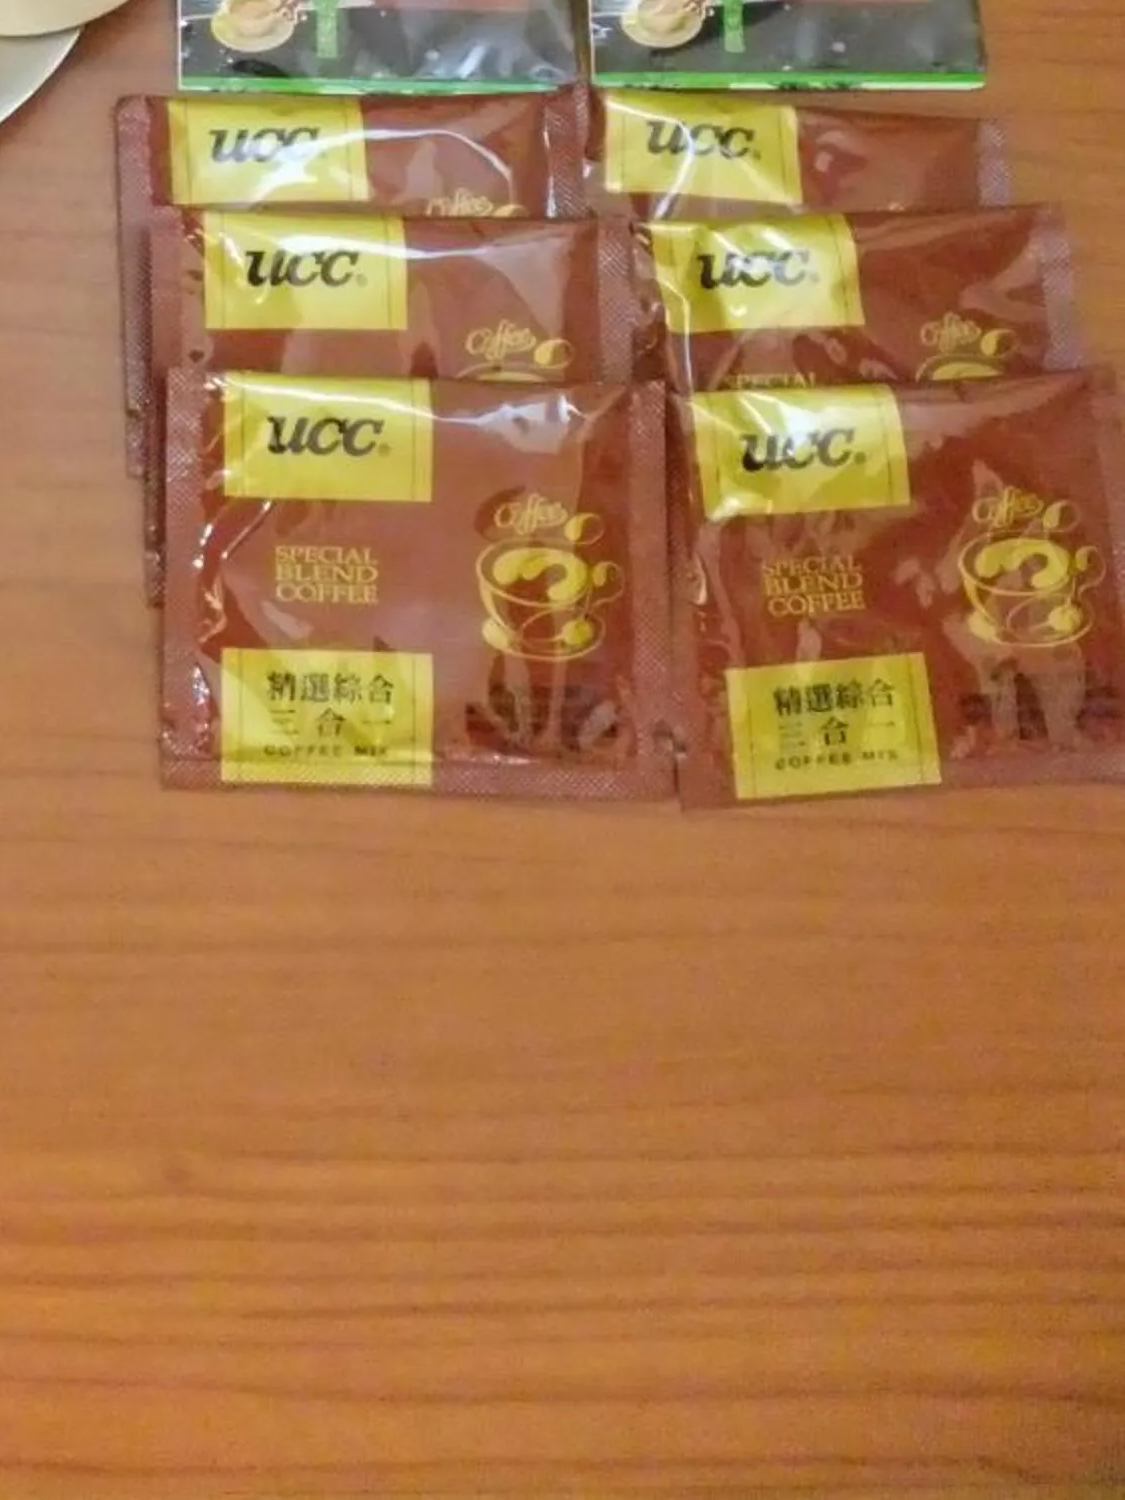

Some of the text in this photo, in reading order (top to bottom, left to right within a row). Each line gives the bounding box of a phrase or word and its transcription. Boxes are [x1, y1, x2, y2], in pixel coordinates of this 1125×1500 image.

[275, 545, 378, 565] SPECIAL
[761, 556, 862, 577] SPECIAL
[275, 563, 379, 583] BLEND
[764, 572, 864, 596] BLEND
[275, 582, 379, 604] COFFEE
[767, 591, 866, 617] COFFEE
[266, 671, 394, 704] 精選綜合
[773, 677, 896, 716] 精選綜合
